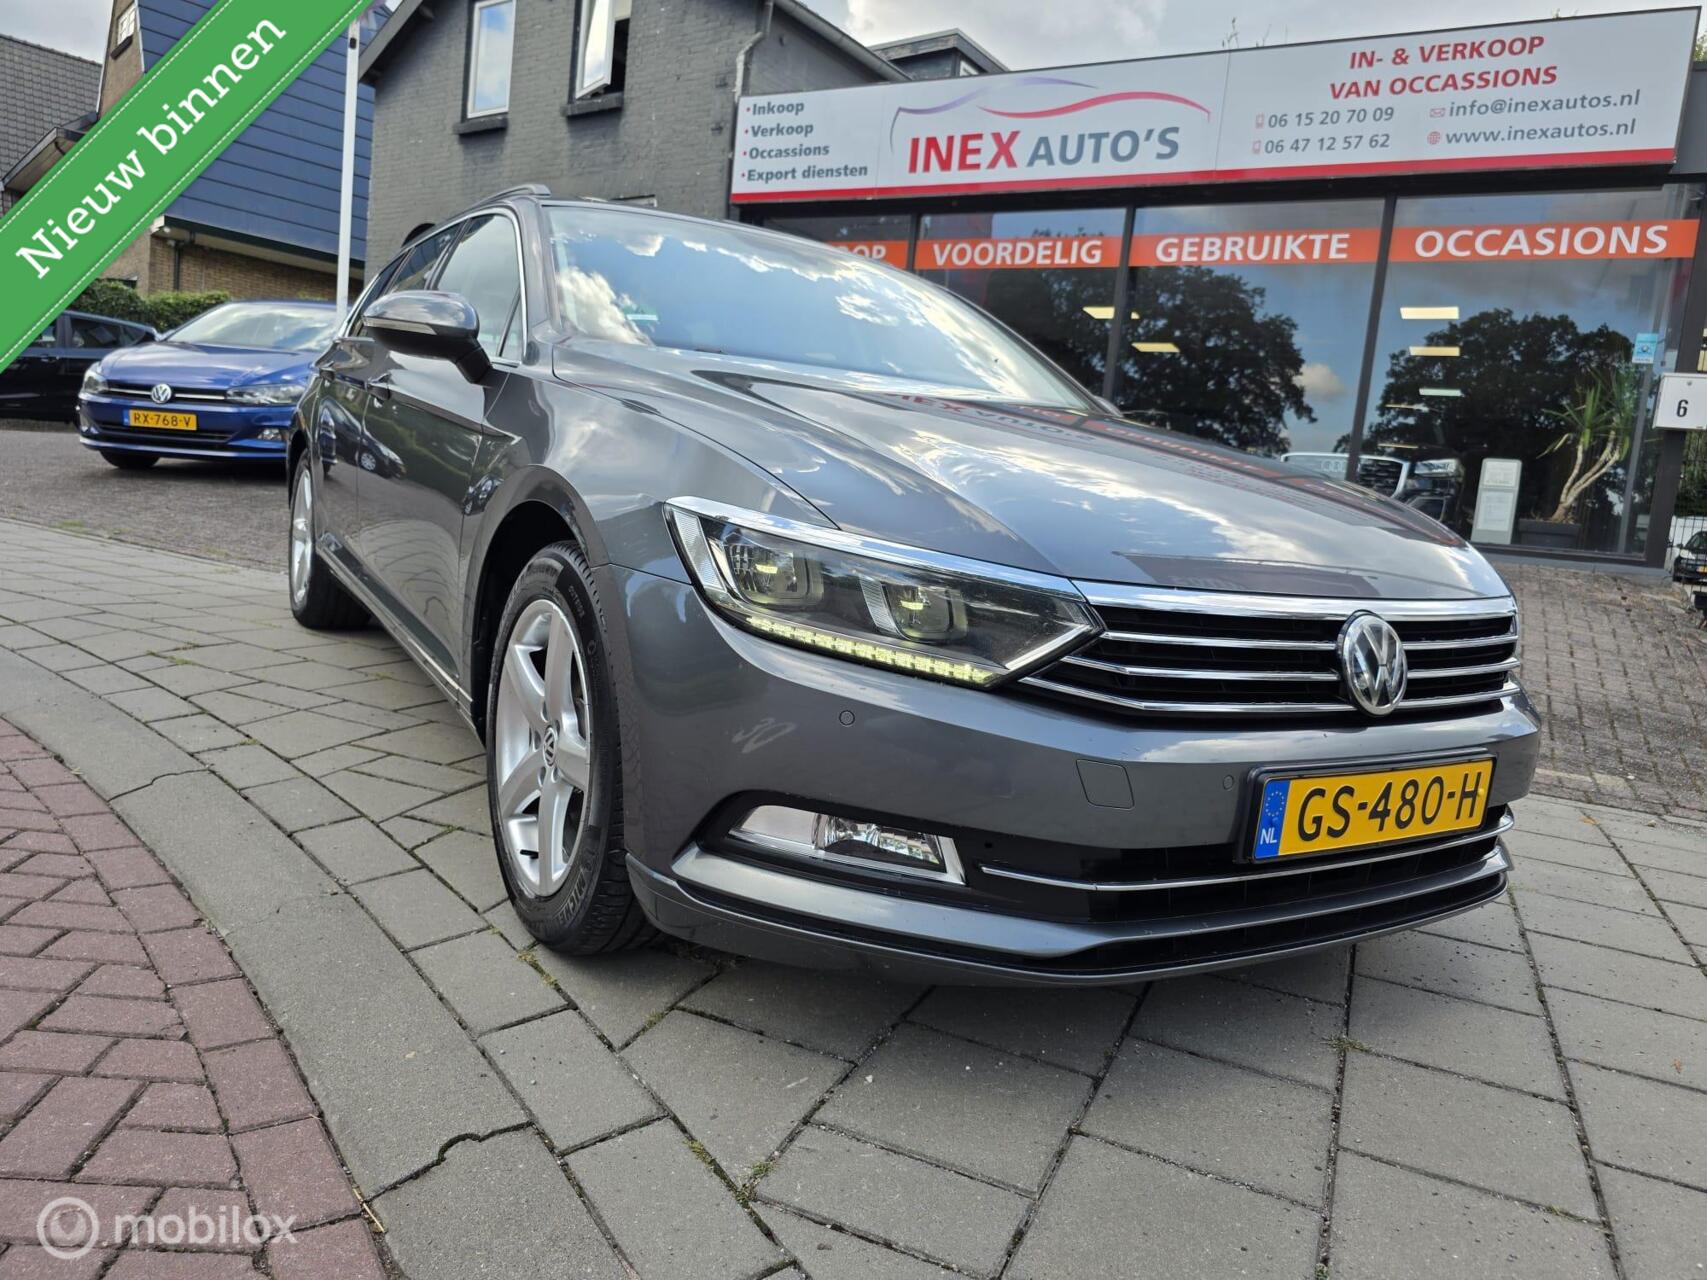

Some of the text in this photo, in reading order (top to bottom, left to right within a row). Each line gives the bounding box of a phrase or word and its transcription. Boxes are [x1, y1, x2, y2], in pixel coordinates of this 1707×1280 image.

[1349, 36, 1544, 69] IN- & VERKOOP
[1330, 66, 1557, 100] VAN OCCASSIONS
[752, 102, 805, 116] Inkoop
[1449, 89, 1640, 117] info@inexautos.nl
[1268, 106, 1395, 128] 06 15 20 70 09
[751, 123, 814, 138] Verkoop
[1445, 118, 1636, 144] www.inexautos.nl
[749, 144, 830, 159] Occassions
[908, 126, 1180, 174] INEX AUTO'S
[1264, 133, 1390, 154] 06 47 12 57 62
[747, 164, 868, 184] Export diensten
[933, 240, 1102, 265] VOORDELIG
[1156, 233, 1350, 262] GEBRUIKTE
[1415, 225, 1669, 258] OCCASIONS
[133, 412, 192, 428] RX-768-V
[1676, 399, 1689, 418] 6
[1298, 771, 1482, 842] GS-480-H
[1260, 828, 1277, 844] NL
